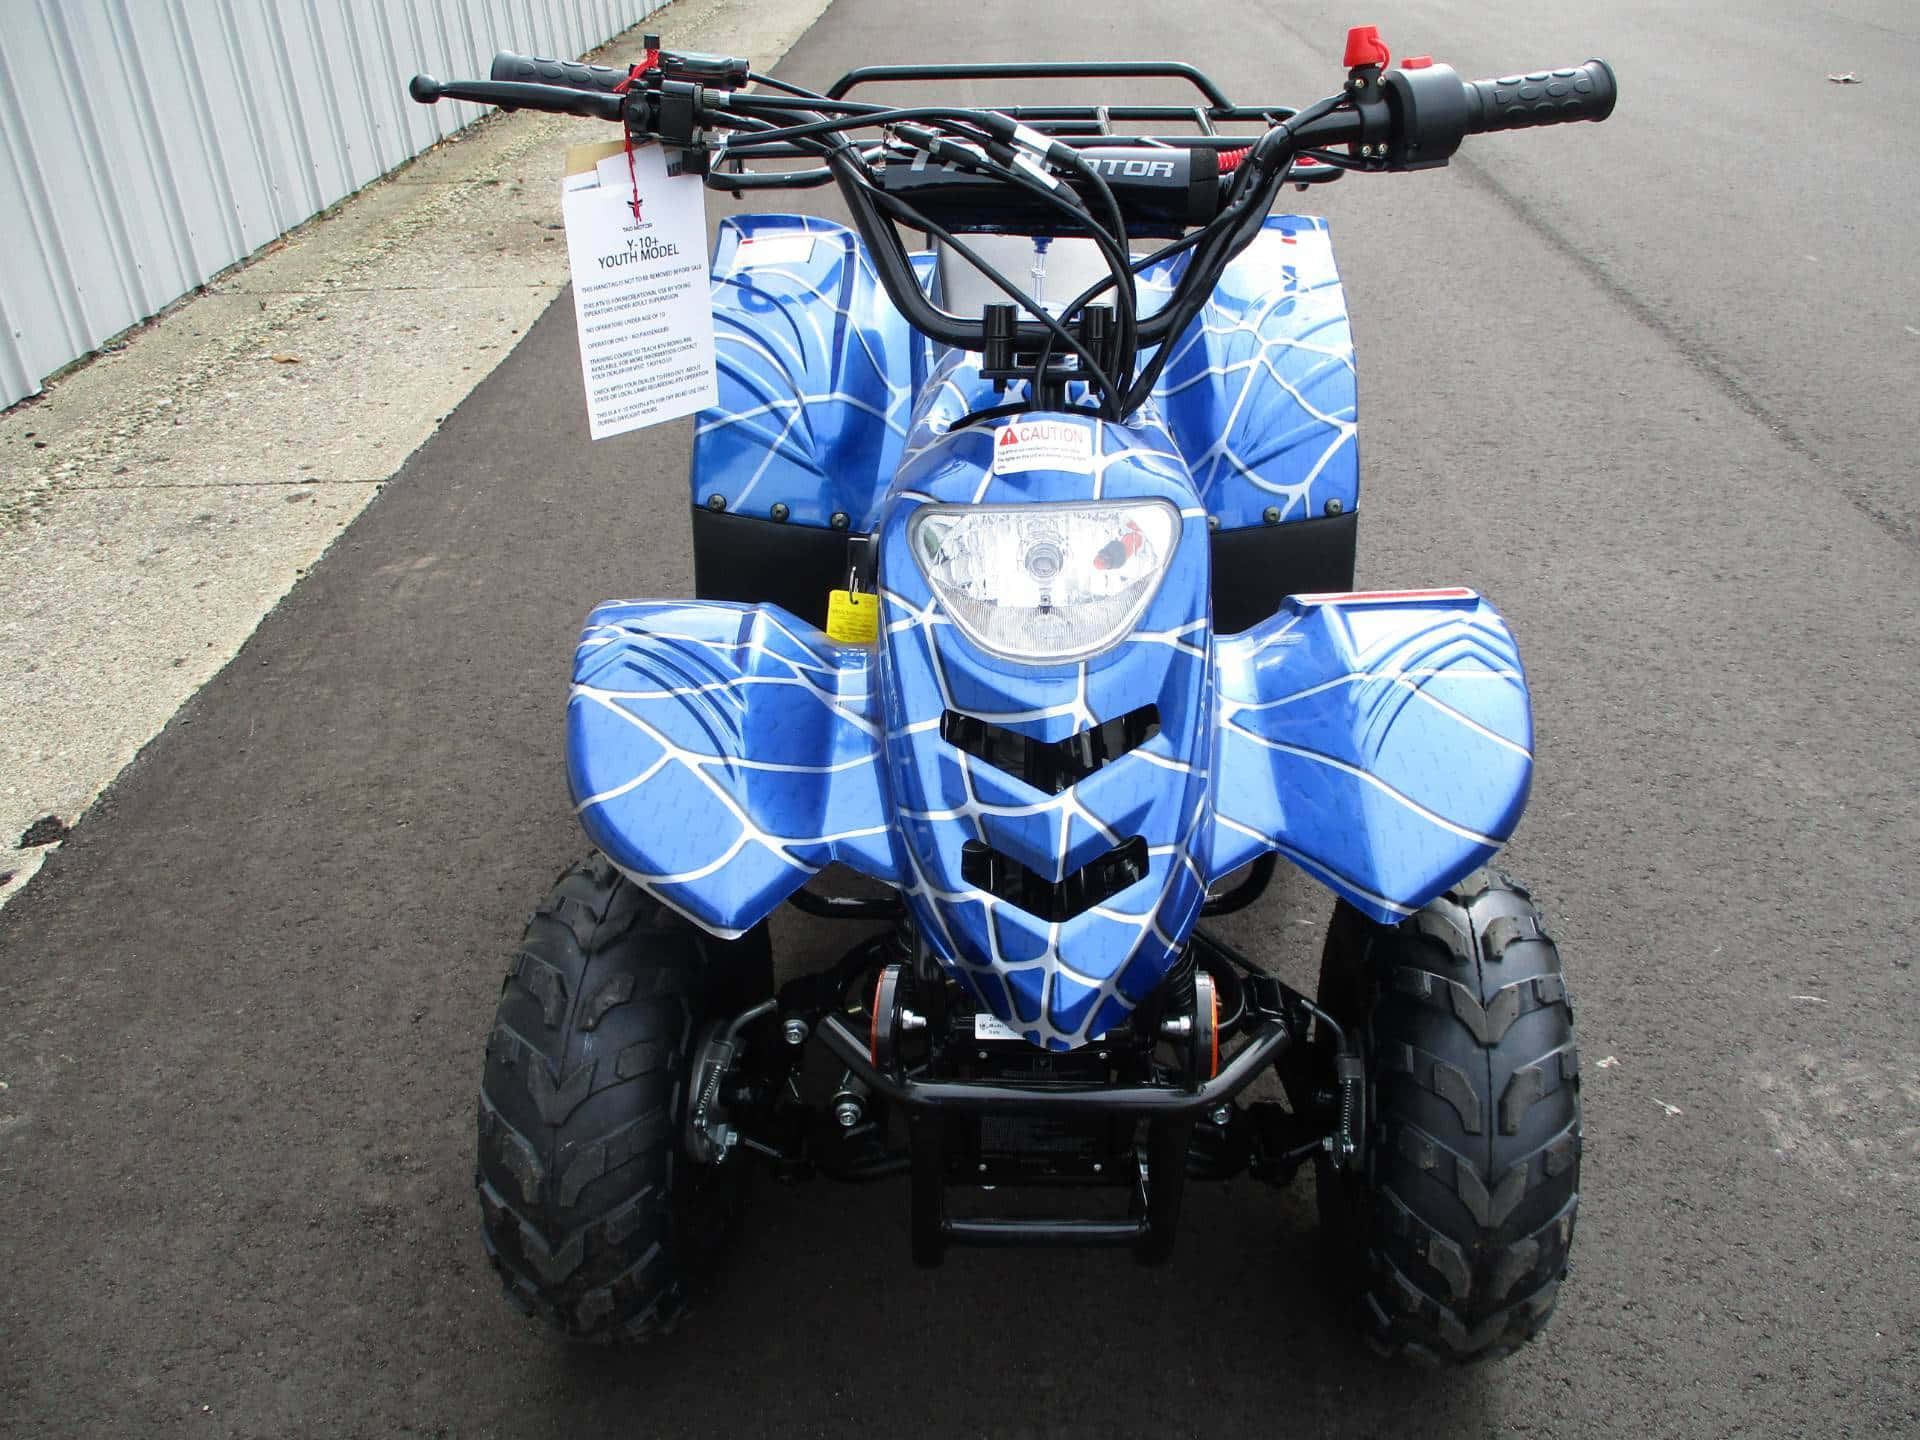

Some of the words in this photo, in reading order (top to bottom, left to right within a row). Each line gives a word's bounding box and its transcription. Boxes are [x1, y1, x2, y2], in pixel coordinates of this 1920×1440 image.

[626, 236, 660, 250] Y-10+
[598, 250, 638, 269] YOUTH
[640, 243, 680, 262] MODEL
[582, 286, 592, 294] THIS
[650, 270, 672, 280] REMOVED
[674, 267, 689, 275] BEFORE
[621, 289, 657, 302] RECREATIONAL
[675, 282, 691, 291] YOUNG
[584, 307, 613, 318] OPERATORS
[614, 303, 631, 312] UNDER
[632, 300, 647, 308] ADULT
[649, 293, 678, 304] SUPERVISION
[624, 317, 641, 325] UNDER
[588, 339, 614, 350] OPERATOR
[615, 335, 628, 344] ONLY
[590, 355, 613, 365] TRAINING
[614, 350, 632, 360] COURSE
[641, 344, 656, 353] TEACH
[667, 338, 682, 347] RIDING
[630, 355, 643, 364] MORE
[644, 347, 677, 360] INFORMATION
[678, 342, 697, 352] CONTACT
[592, 373, 605, 381] YOUR
[607, 368, 624, 377] DEALER
[594, 388, 609, 396] CHECK
[611, 384, 623, 392] WITH
[624, 381, 637, 389] YOUR
[638, 376, 655, 385] DEALER
[664, 371, 674, 379] FIND
[686, 365, 701, 373] ABOUT
[595, 395, 609, 404] STATE
[618, 389, 633, 398] LOCAL
[648, 379, 674, 390] REGARDING
[684, 370, 708, 381] OPERATION
[629, 402, 643, 410] YOUTH
[598, 417, 616, 427] DURING
[617, 411, 640, 422] DAYLIGHT
[1020, 426, 1083, 443] CAUTION
